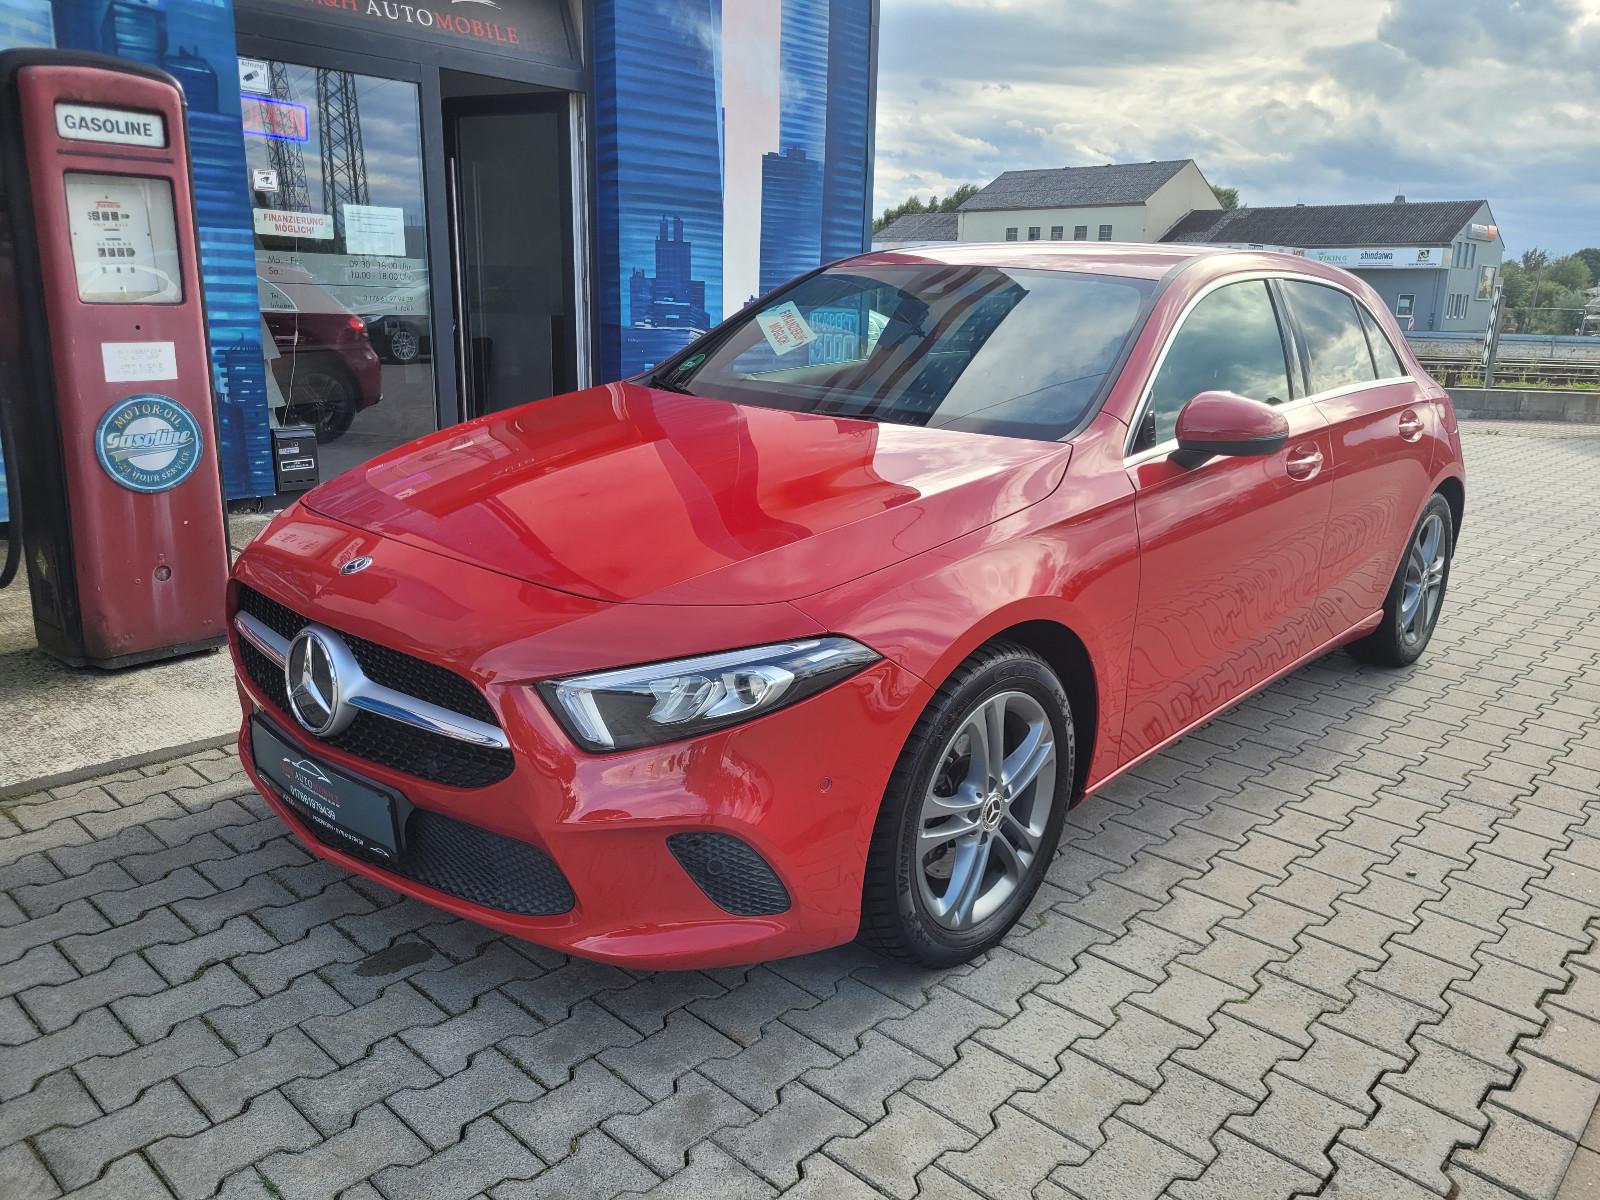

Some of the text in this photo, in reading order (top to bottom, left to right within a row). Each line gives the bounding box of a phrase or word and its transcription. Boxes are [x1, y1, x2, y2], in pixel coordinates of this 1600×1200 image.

[366, 0, 519, 44] AUTOMOBILE
[64, 114, 153, 137] GASOLINE
[263, 213, 324, 226] FINANZIERUNG
[1318, 254, 1348, 262] VIKING
[1359, 250, 1393, 261] shindaiwa
